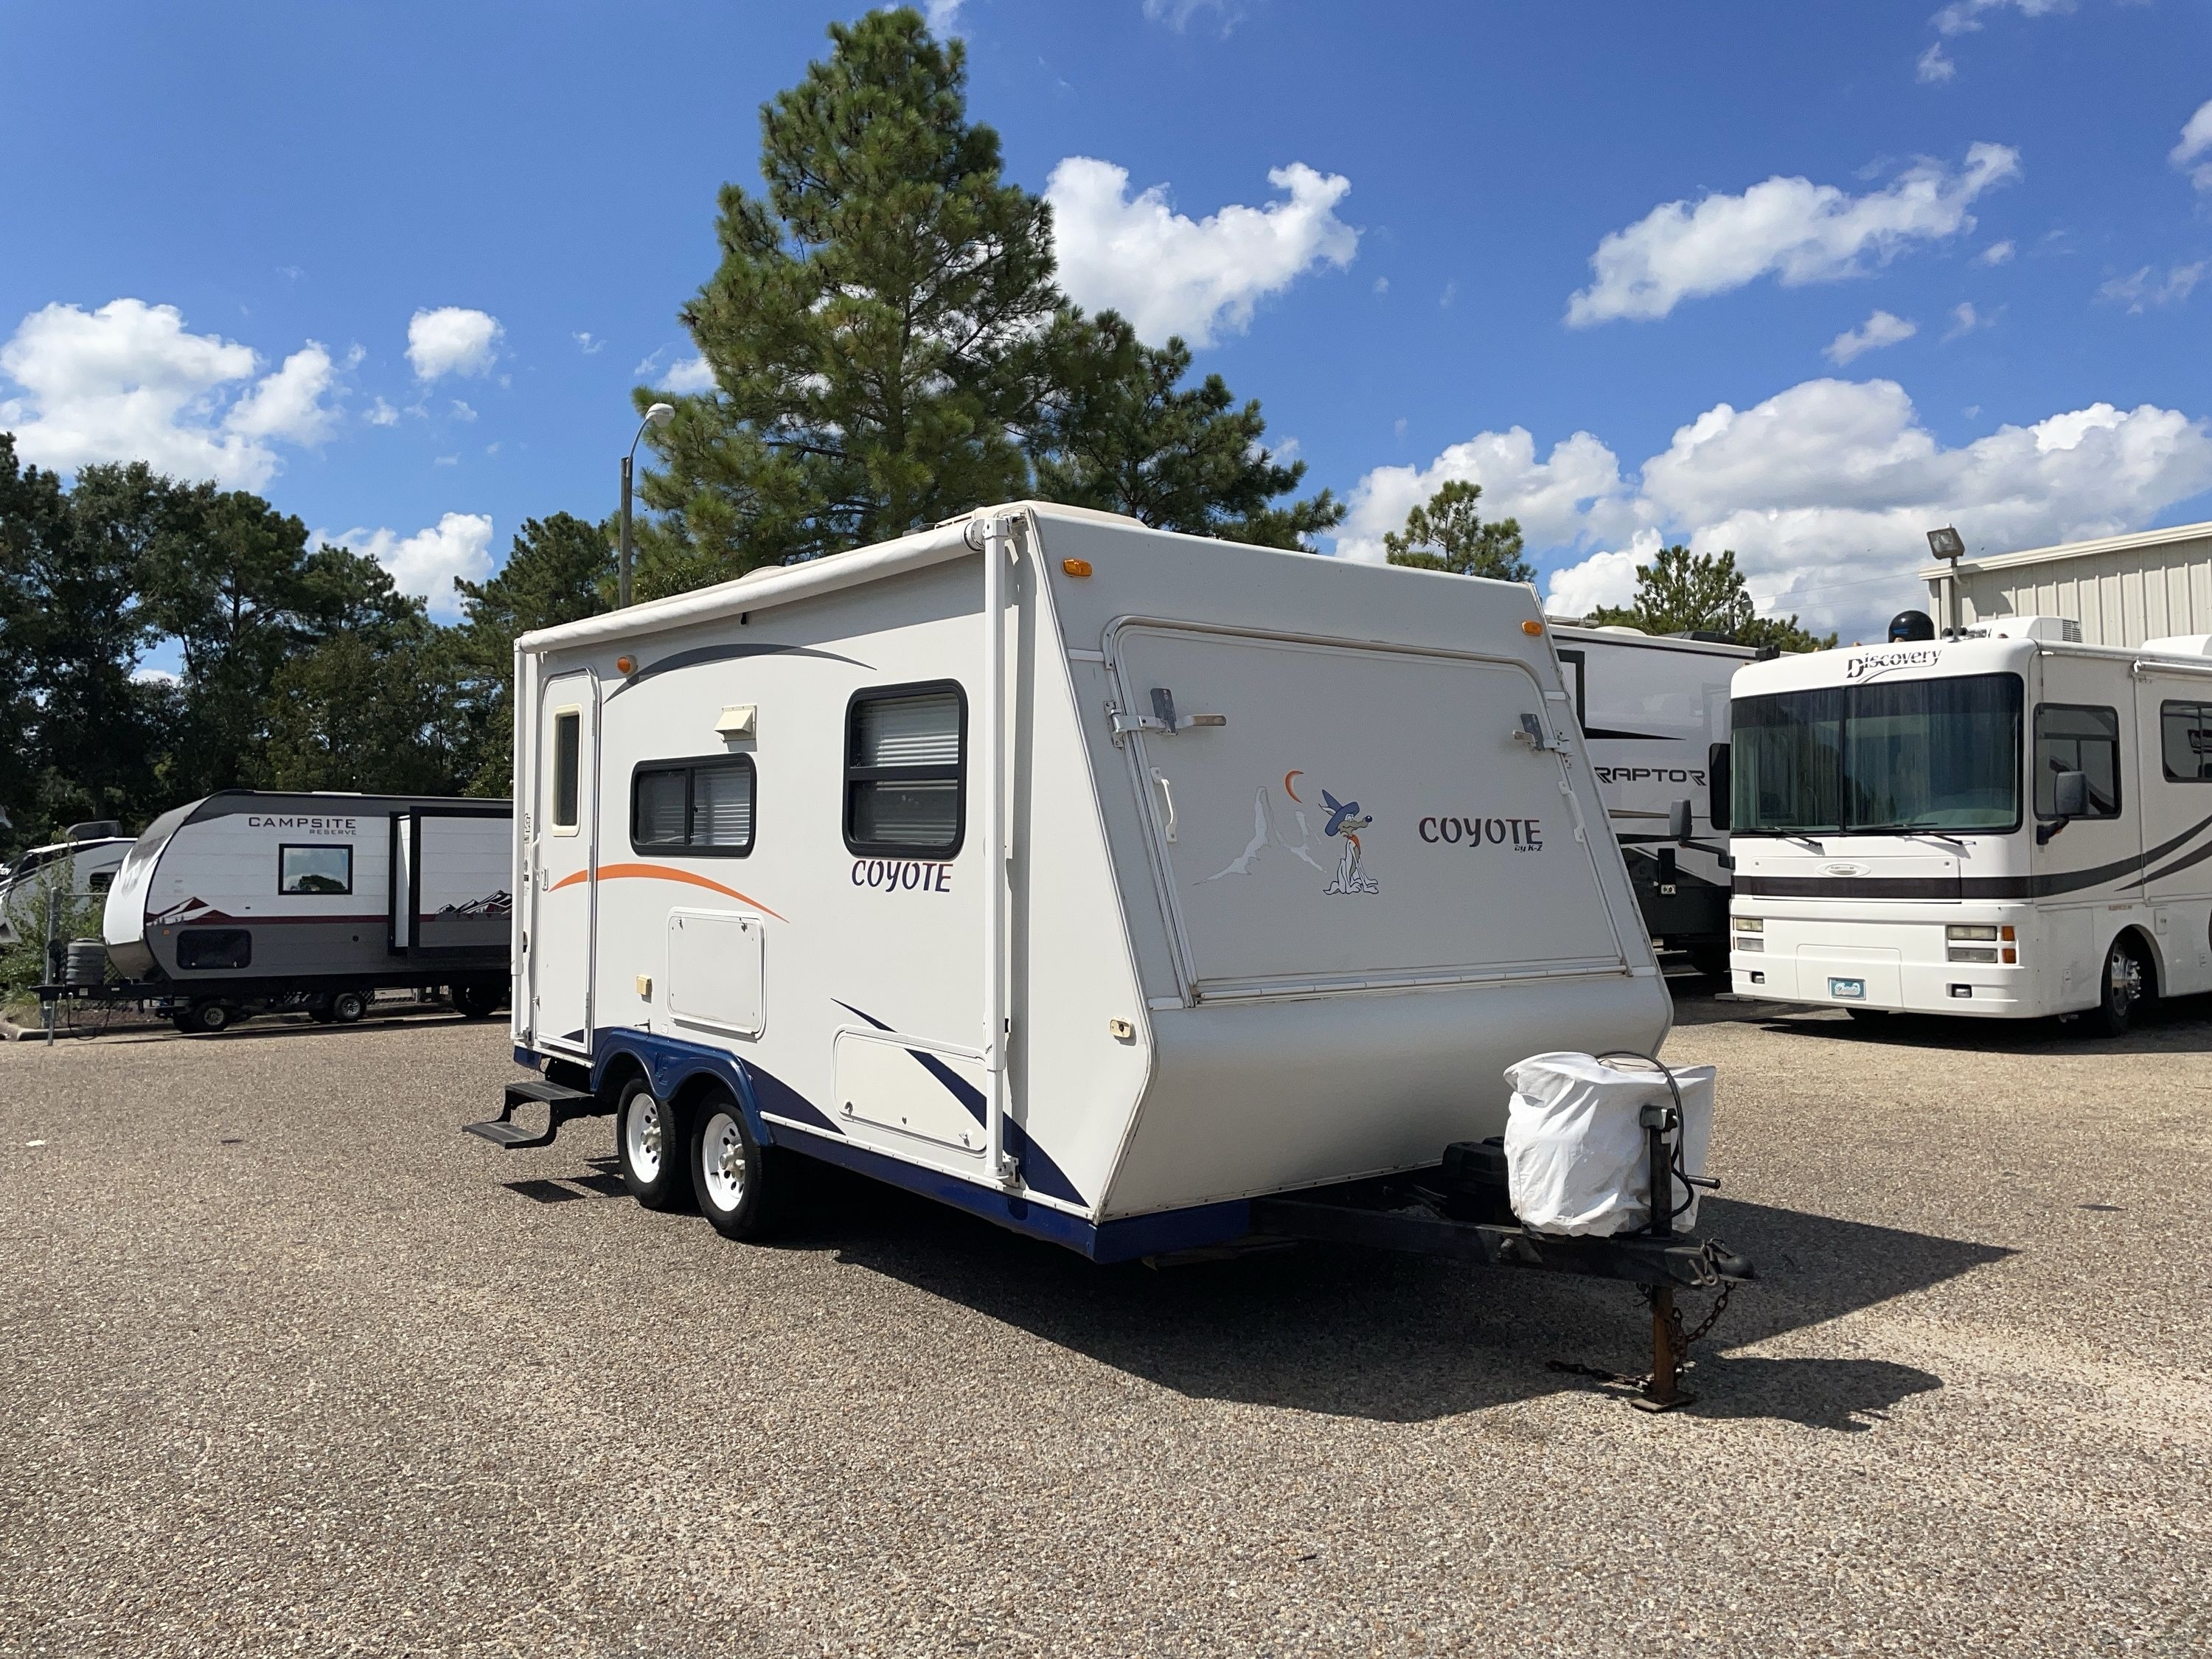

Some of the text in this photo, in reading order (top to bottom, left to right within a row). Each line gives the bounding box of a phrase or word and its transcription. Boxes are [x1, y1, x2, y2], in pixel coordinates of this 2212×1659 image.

[1846, 650, 1941, 678] Discovery
[1594, 767, 1707, 786] RAPTOR
[248, 817, 356, 829] CAMPSITE
[1419, 817, 1543, 847] COYOTE
[852, 860, 953, 892] COYOTE
